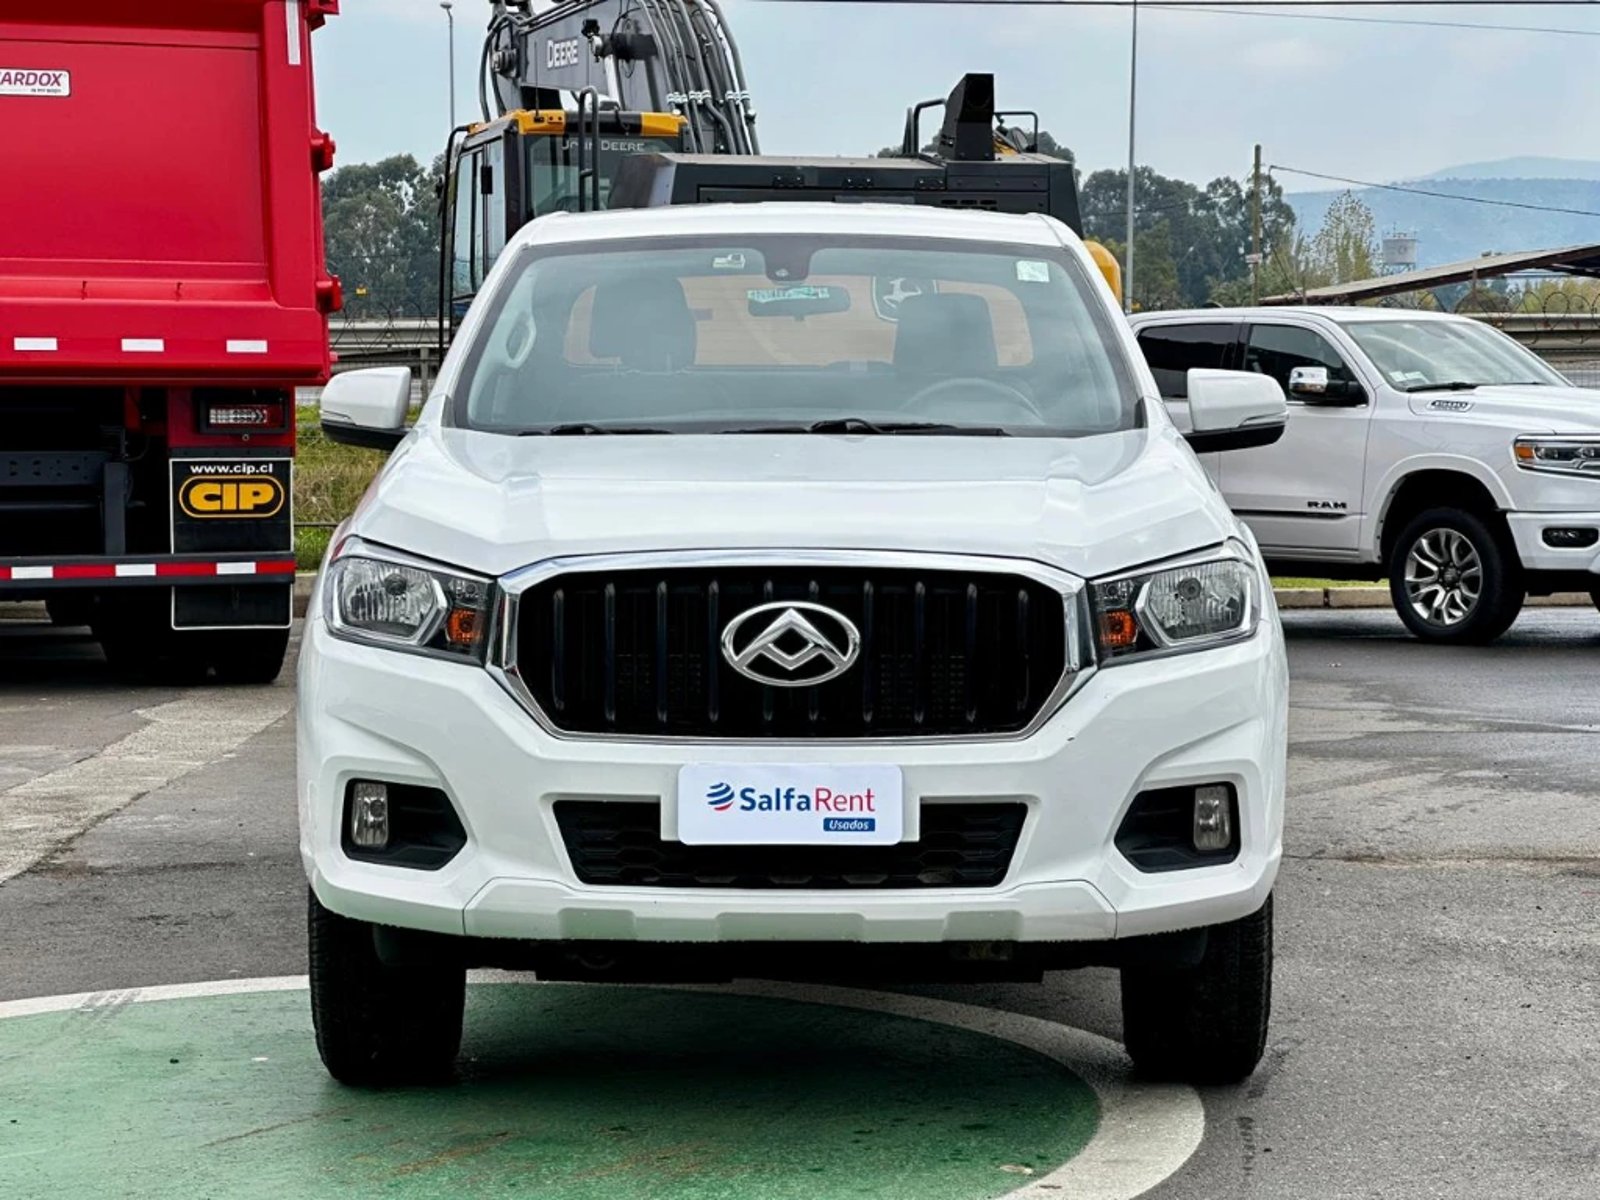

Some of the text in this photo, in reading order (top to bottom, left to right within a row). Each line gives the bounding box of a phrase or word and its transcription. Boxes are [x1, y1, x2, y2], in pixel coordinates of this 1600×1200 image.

[547, 40, 578, 68] DEERE
[0, 71, 63, 87] ARDOX
[601, 140, 645, 152] DEERE
[190, 463, 273, 475] www.cip.cl
[189, 483, 275, 511] CIP
[1307, 501, 1347, 509] RAM
[739, 787, 876, 812] SalfaRent
[829, 819, 869, 831] Usados
